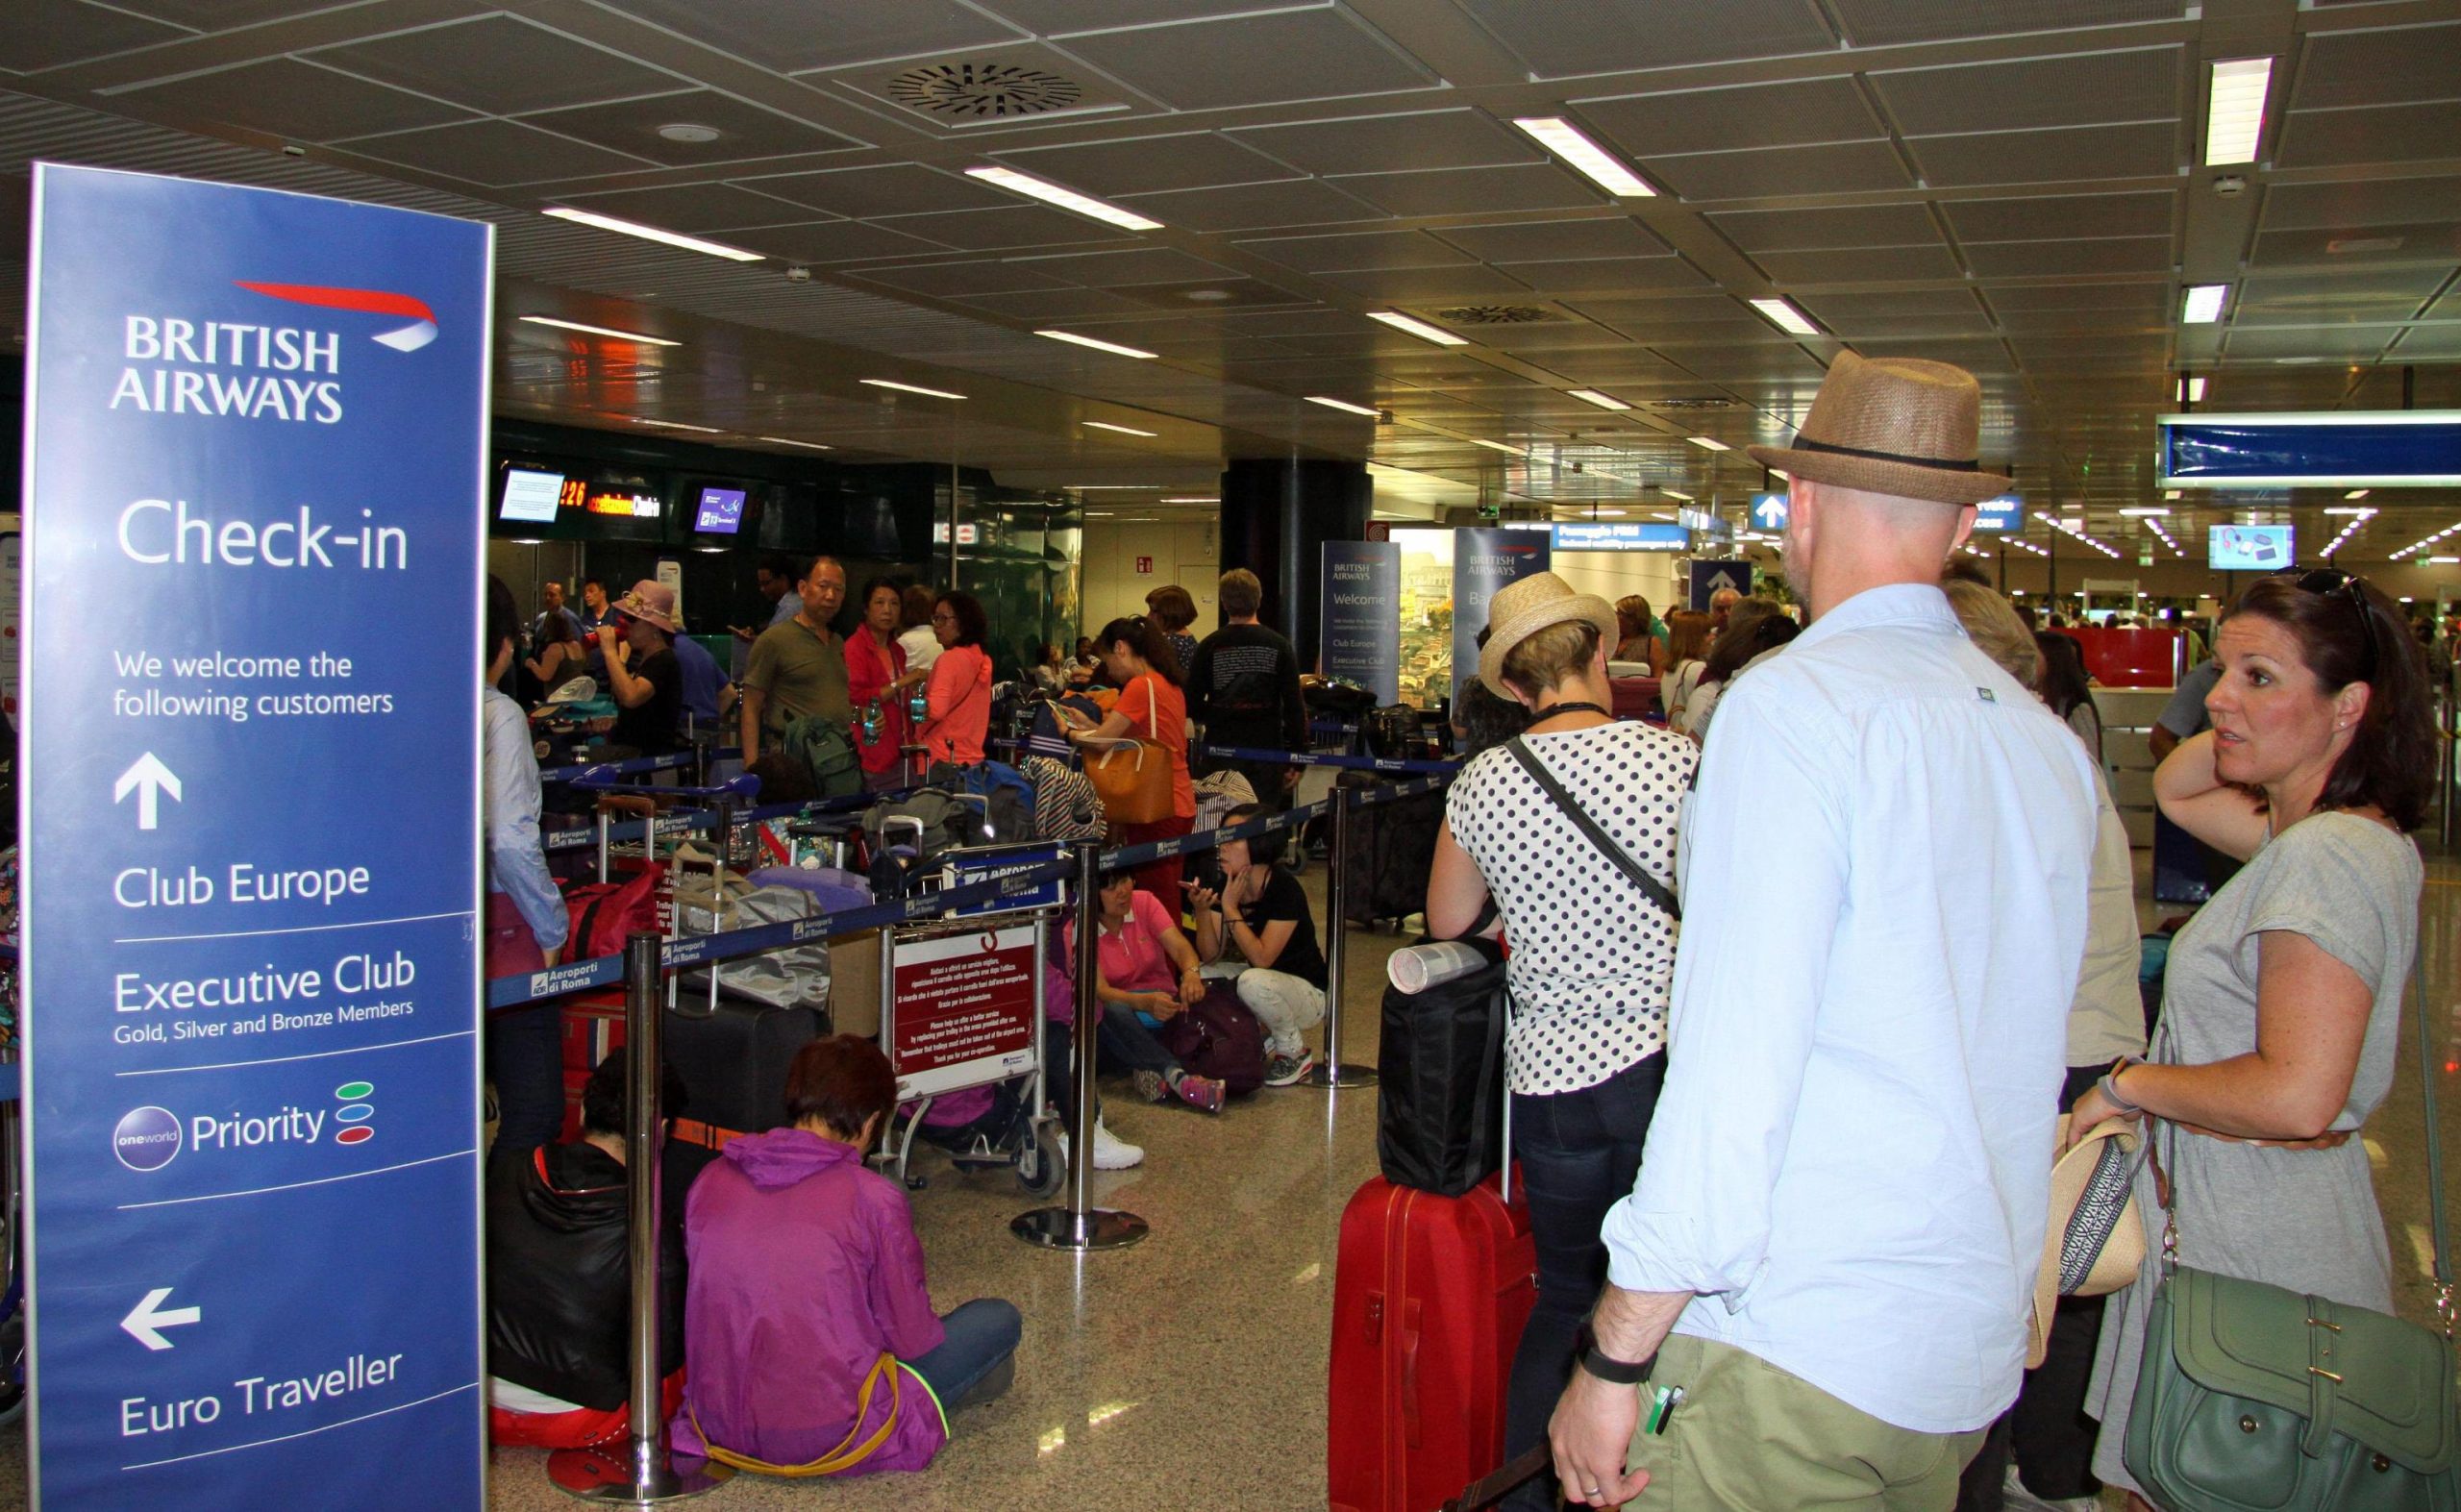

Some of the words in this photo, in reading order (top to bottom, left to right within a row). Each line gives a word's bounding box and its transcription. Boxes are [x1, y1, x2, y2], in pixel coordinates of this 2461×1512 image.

[125, 315, 339, 374] BRITISH
[110, 368, 342, 424] AIRWAYS
[117, 499, 407, 570] Check-in
[1334, 563, 1370, 572] BRITISH
[1470, 556, 1515, 565] BRITISH
[1468, 565, 1515, 577] AIRWAYS
[1334, 593, 1385, 606] Welcome
[1469, 592, 1489, 606] Ba
[1332, 638, 1349, 647] Club
[114, 650, 162, 677] We
[173, 651, 301, 678] welcome
[310, 652, 352, 677] the
[114, 689, 249, 721] following
[258, 689, 393, 715] customers
[665, 815, 692, 826] Aeroporti
[559, 829, 592, 839] Aeroporti
[567, 836, 586, 845] Roma
[114, 865, 213, 907] Club
[230, 864, 370, 905] Europe
[673, 940, 706, 954] Aeroporti
[681, 952, 700, 961] Roma
[549, 961, 598, 980] Aeroporti
[115, 965, 320, 1012] Executive
[335, 951, 415, 994] Club
[549, 981, 559, 992] di
[561, 977, 590, 990] Roma
[114, 1023, 167, 1043] Gold,
[174, 1017, 227, 1039] Silver
[233, 1014, 265, 1034] and
[272, 1007, 334, 1031] Bronze
[338, 999, 413, 1022] Members
[118, 1130, 177, 1146] oneworld
[193, 1105, 325, 1152] Priority
[121, 1395, 220, 1437] Euro
[235, 1353, 402, 1414] Traveller
